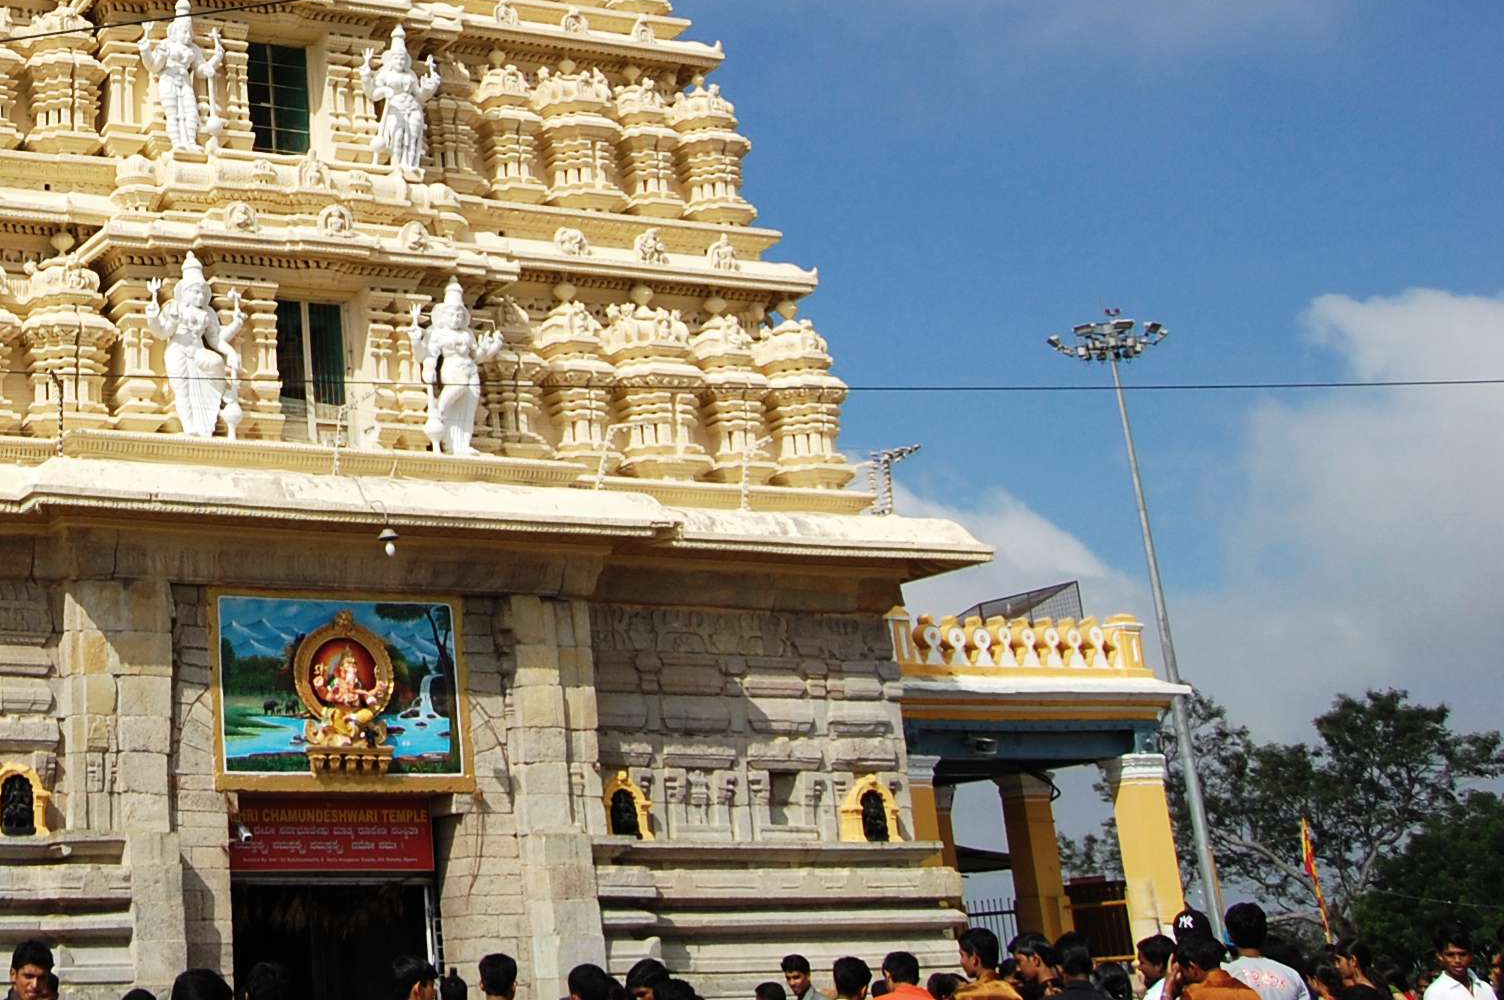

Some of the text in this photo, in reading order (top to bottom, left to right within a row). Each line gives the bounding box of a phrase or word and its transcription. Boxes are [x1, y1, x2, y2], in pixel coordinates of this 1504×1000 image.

[231, 808, 428, 823] HRI CHAMUNDESHWARI TEMPLE
